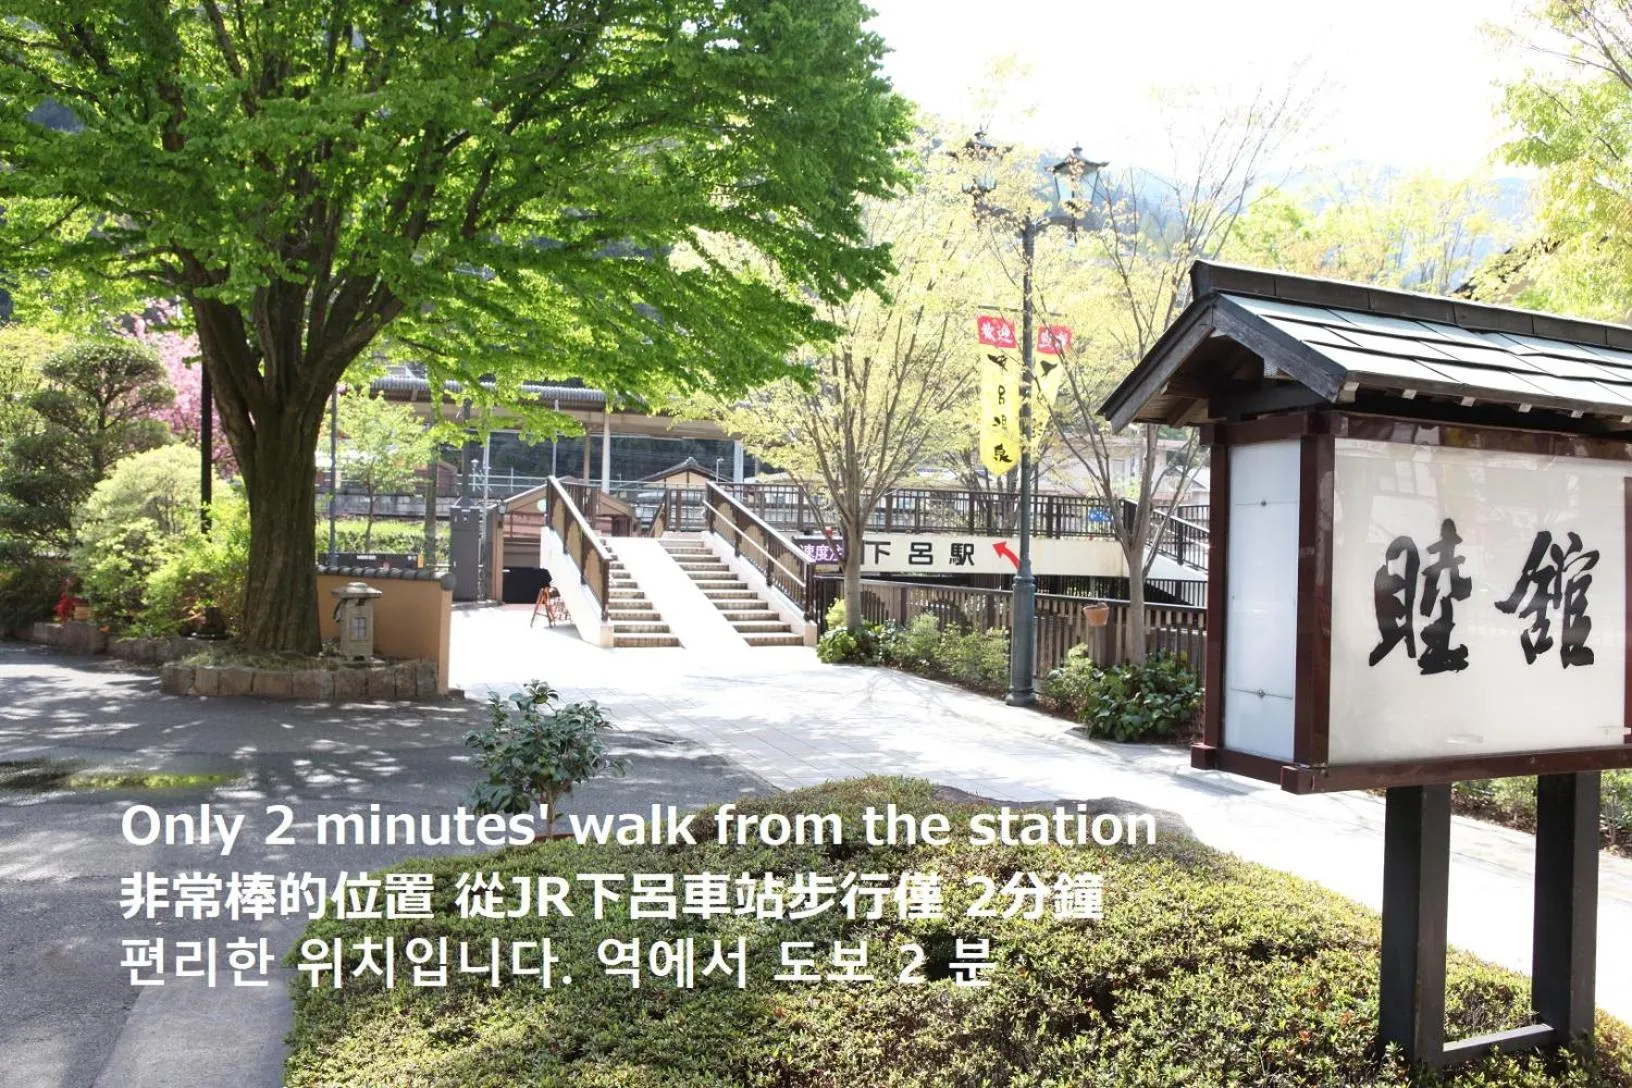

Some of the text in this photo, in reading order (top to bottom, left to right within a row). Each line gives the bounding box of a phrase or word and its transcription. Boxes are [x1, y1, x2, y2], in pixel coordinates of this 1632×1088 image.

[864, 540, 976, 566] 下呂駅
[1368, 517, 1601, 676] 睦館
